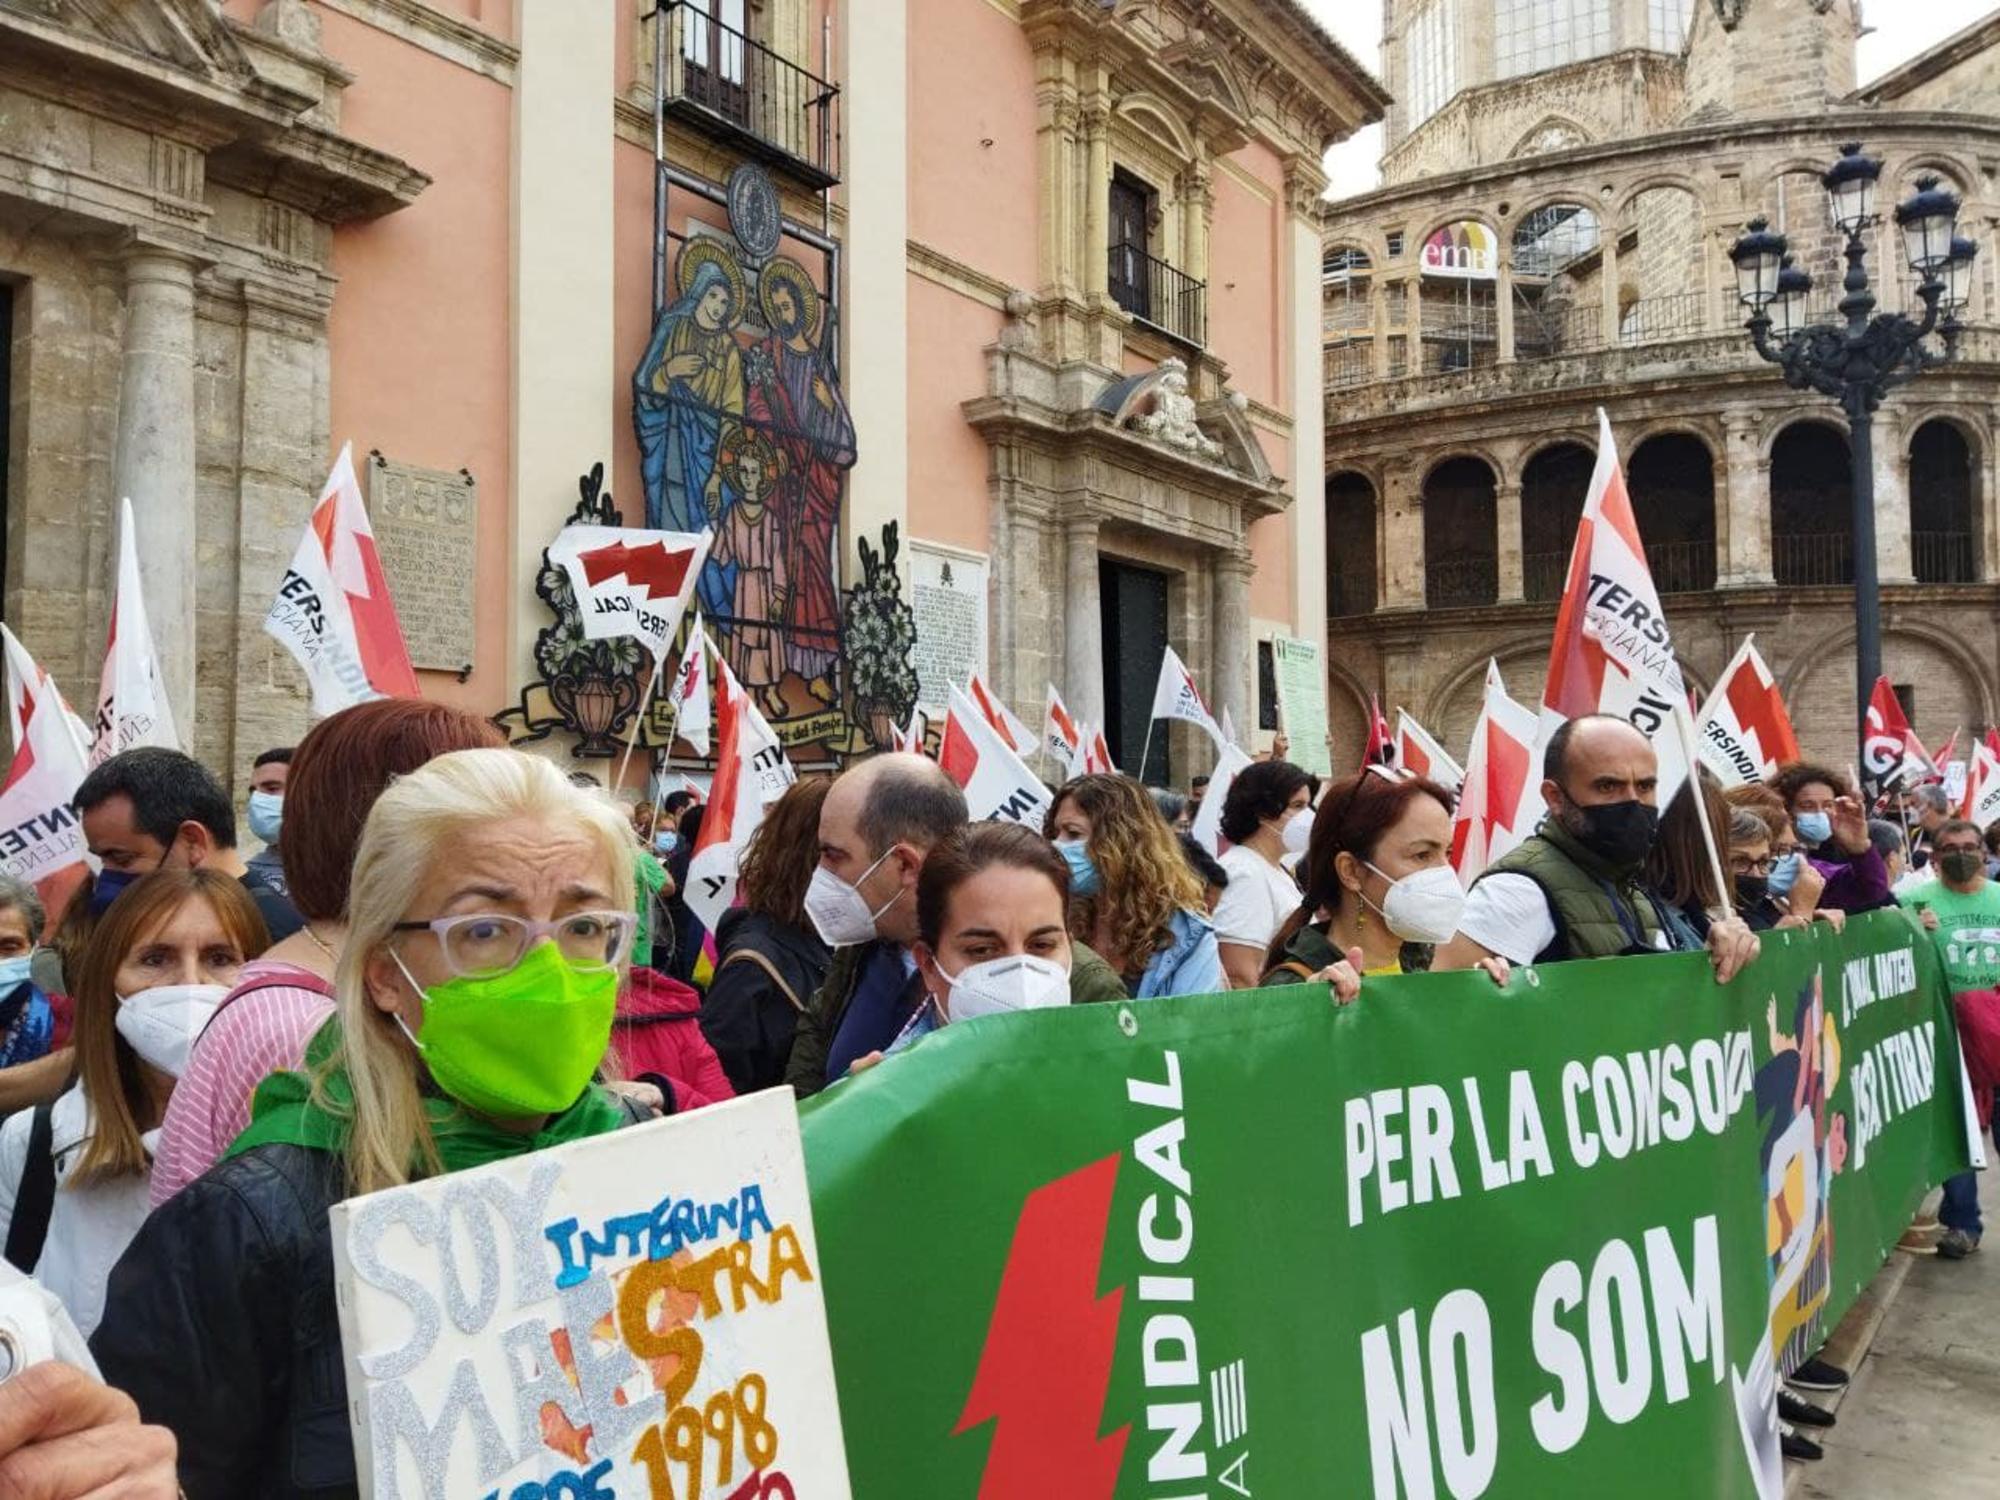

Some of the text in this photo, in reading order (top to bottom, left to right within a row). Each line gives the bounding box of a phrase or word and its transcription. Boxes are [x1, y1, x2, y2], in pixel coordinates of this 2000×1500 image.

[1703, 719, 1763, 785] ERSINDI
[1345, 1084, 1461, 1228] PER
[1463, 1070, 1555, 1191] LA
[347, 1157, 564, 1381] SOY
[1126, 1050, 1209, 1500] NDICAL
[1361, 1214, 1727, 1500] NO SOM
[631, 1373, 778, 1500] 1998
